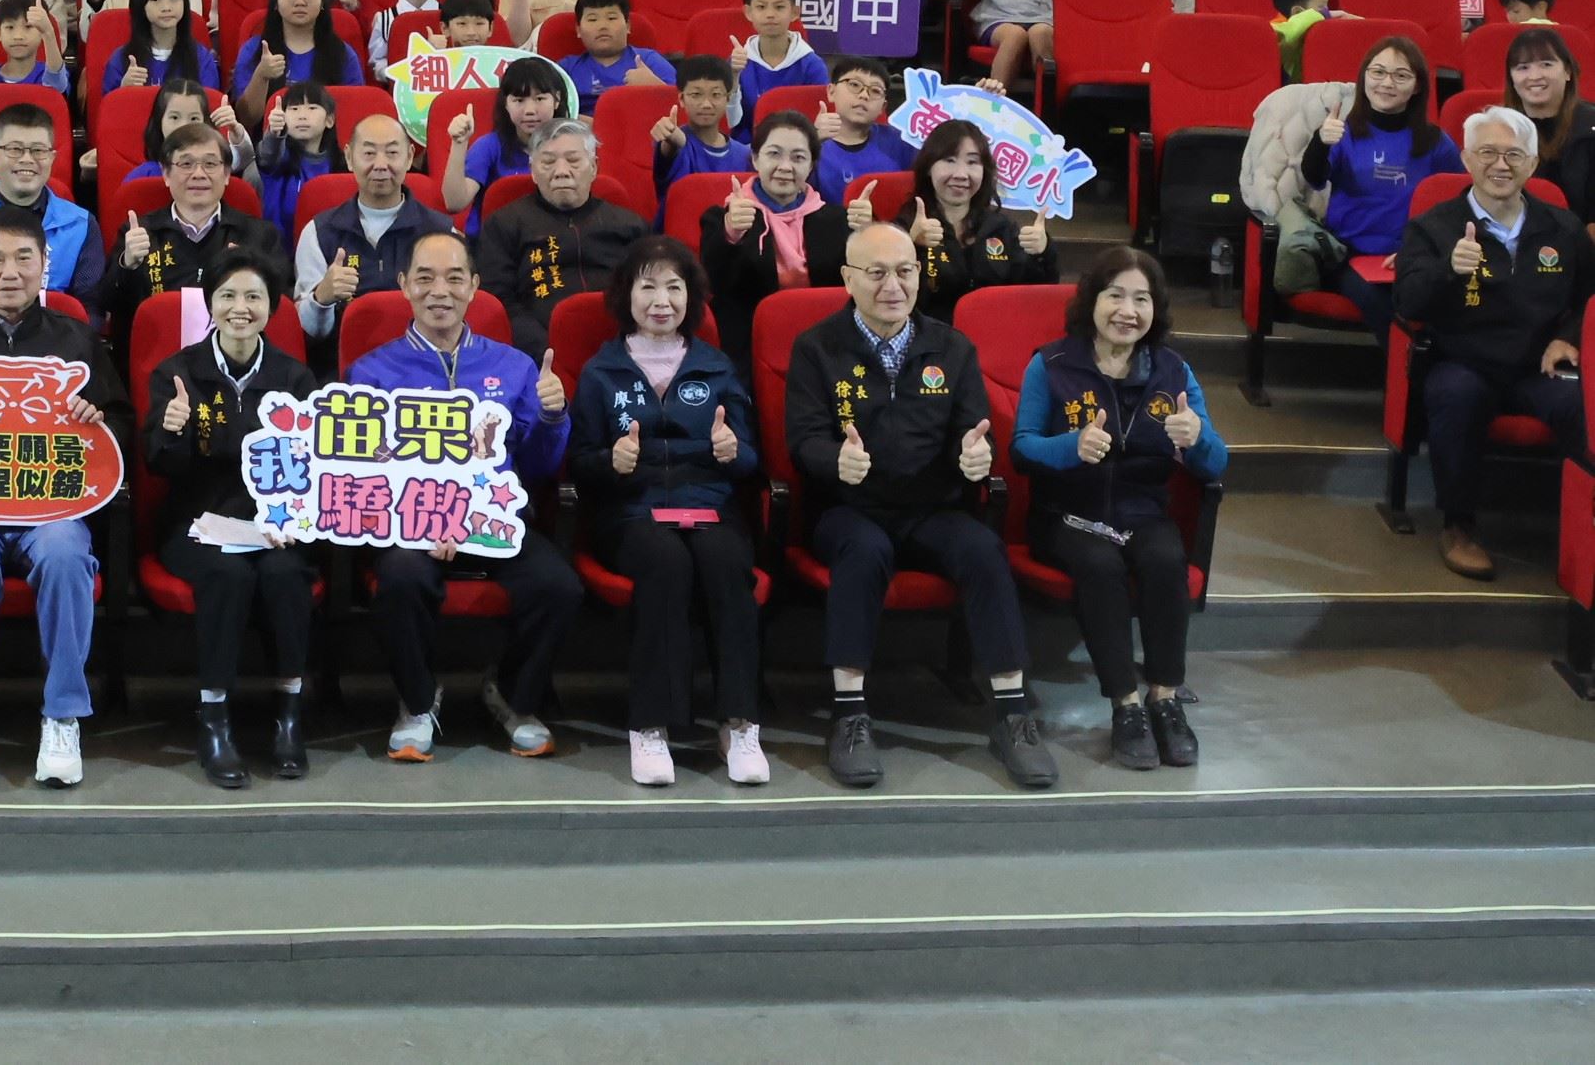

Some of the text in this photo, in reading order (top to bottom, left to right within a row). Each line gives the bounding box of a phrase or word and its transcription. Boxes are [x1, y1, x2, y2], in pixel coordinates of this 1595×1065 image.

[910, 98, 1062, 203] 南國小
[313, 390, 474, 464] 苗栗
[1065, 400, 1082, 432] 曾
[249, 436, 312, 495] 我
[316, 473, 472, 545] 驕傲
